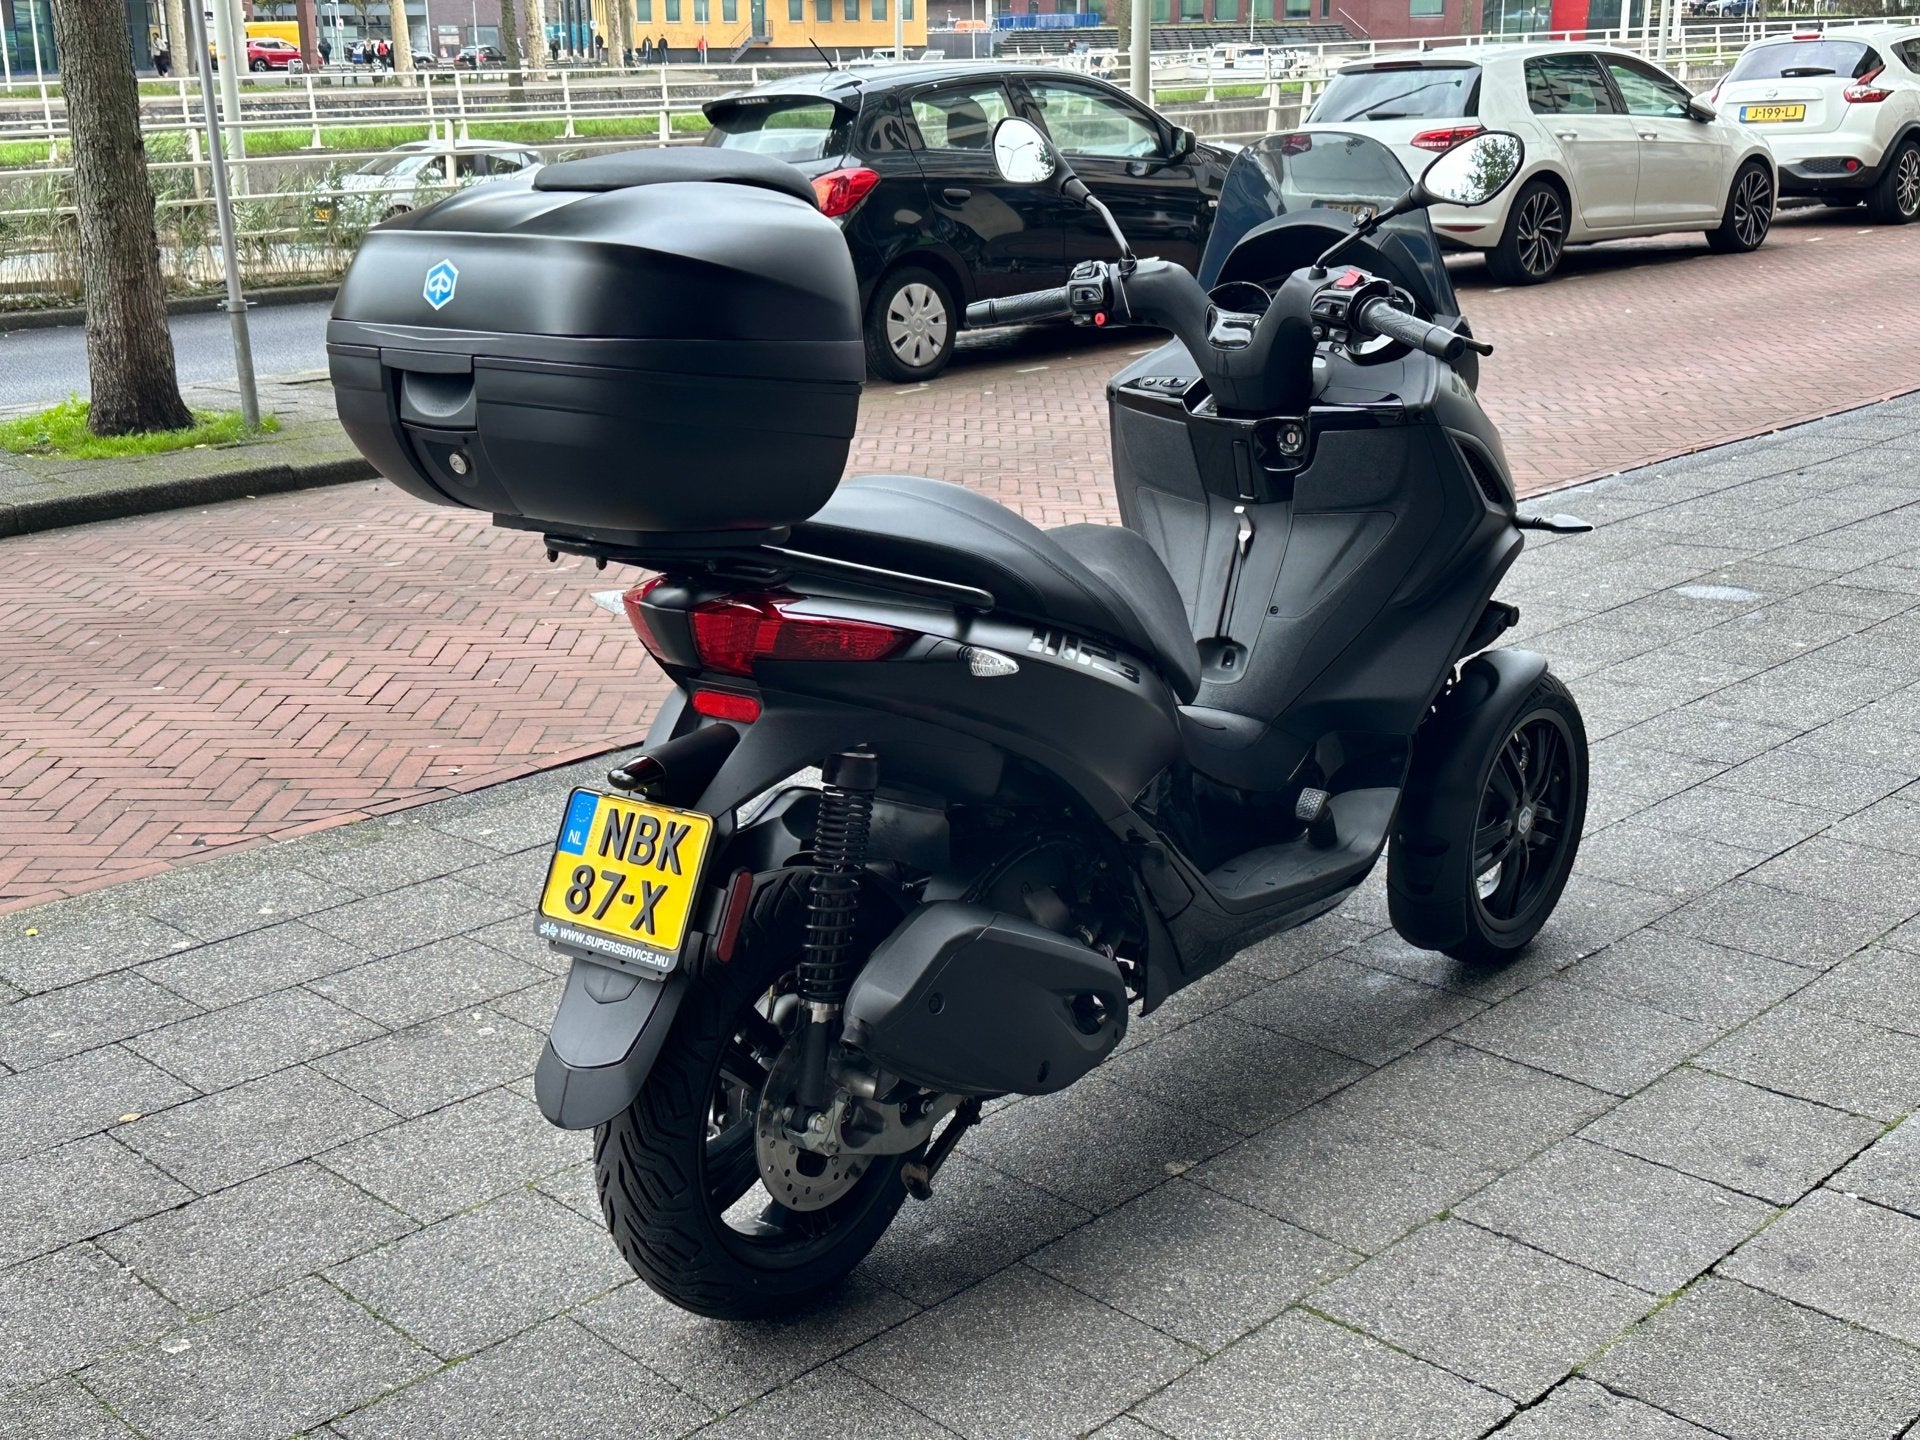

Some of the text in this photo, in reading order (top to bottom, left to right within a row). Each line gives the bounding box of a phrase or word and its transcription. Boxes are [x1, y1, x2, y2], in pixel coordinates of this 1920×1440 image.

[1752, 107, 1798, 119] J-199-LJ
[566, 829, 583, 846] NL
[598, 808, 692, 876] NBK
[565, 864, 669, 936] 87-X
[560, 927, 670, 968] WWW.SUPERSERVICE.NU
